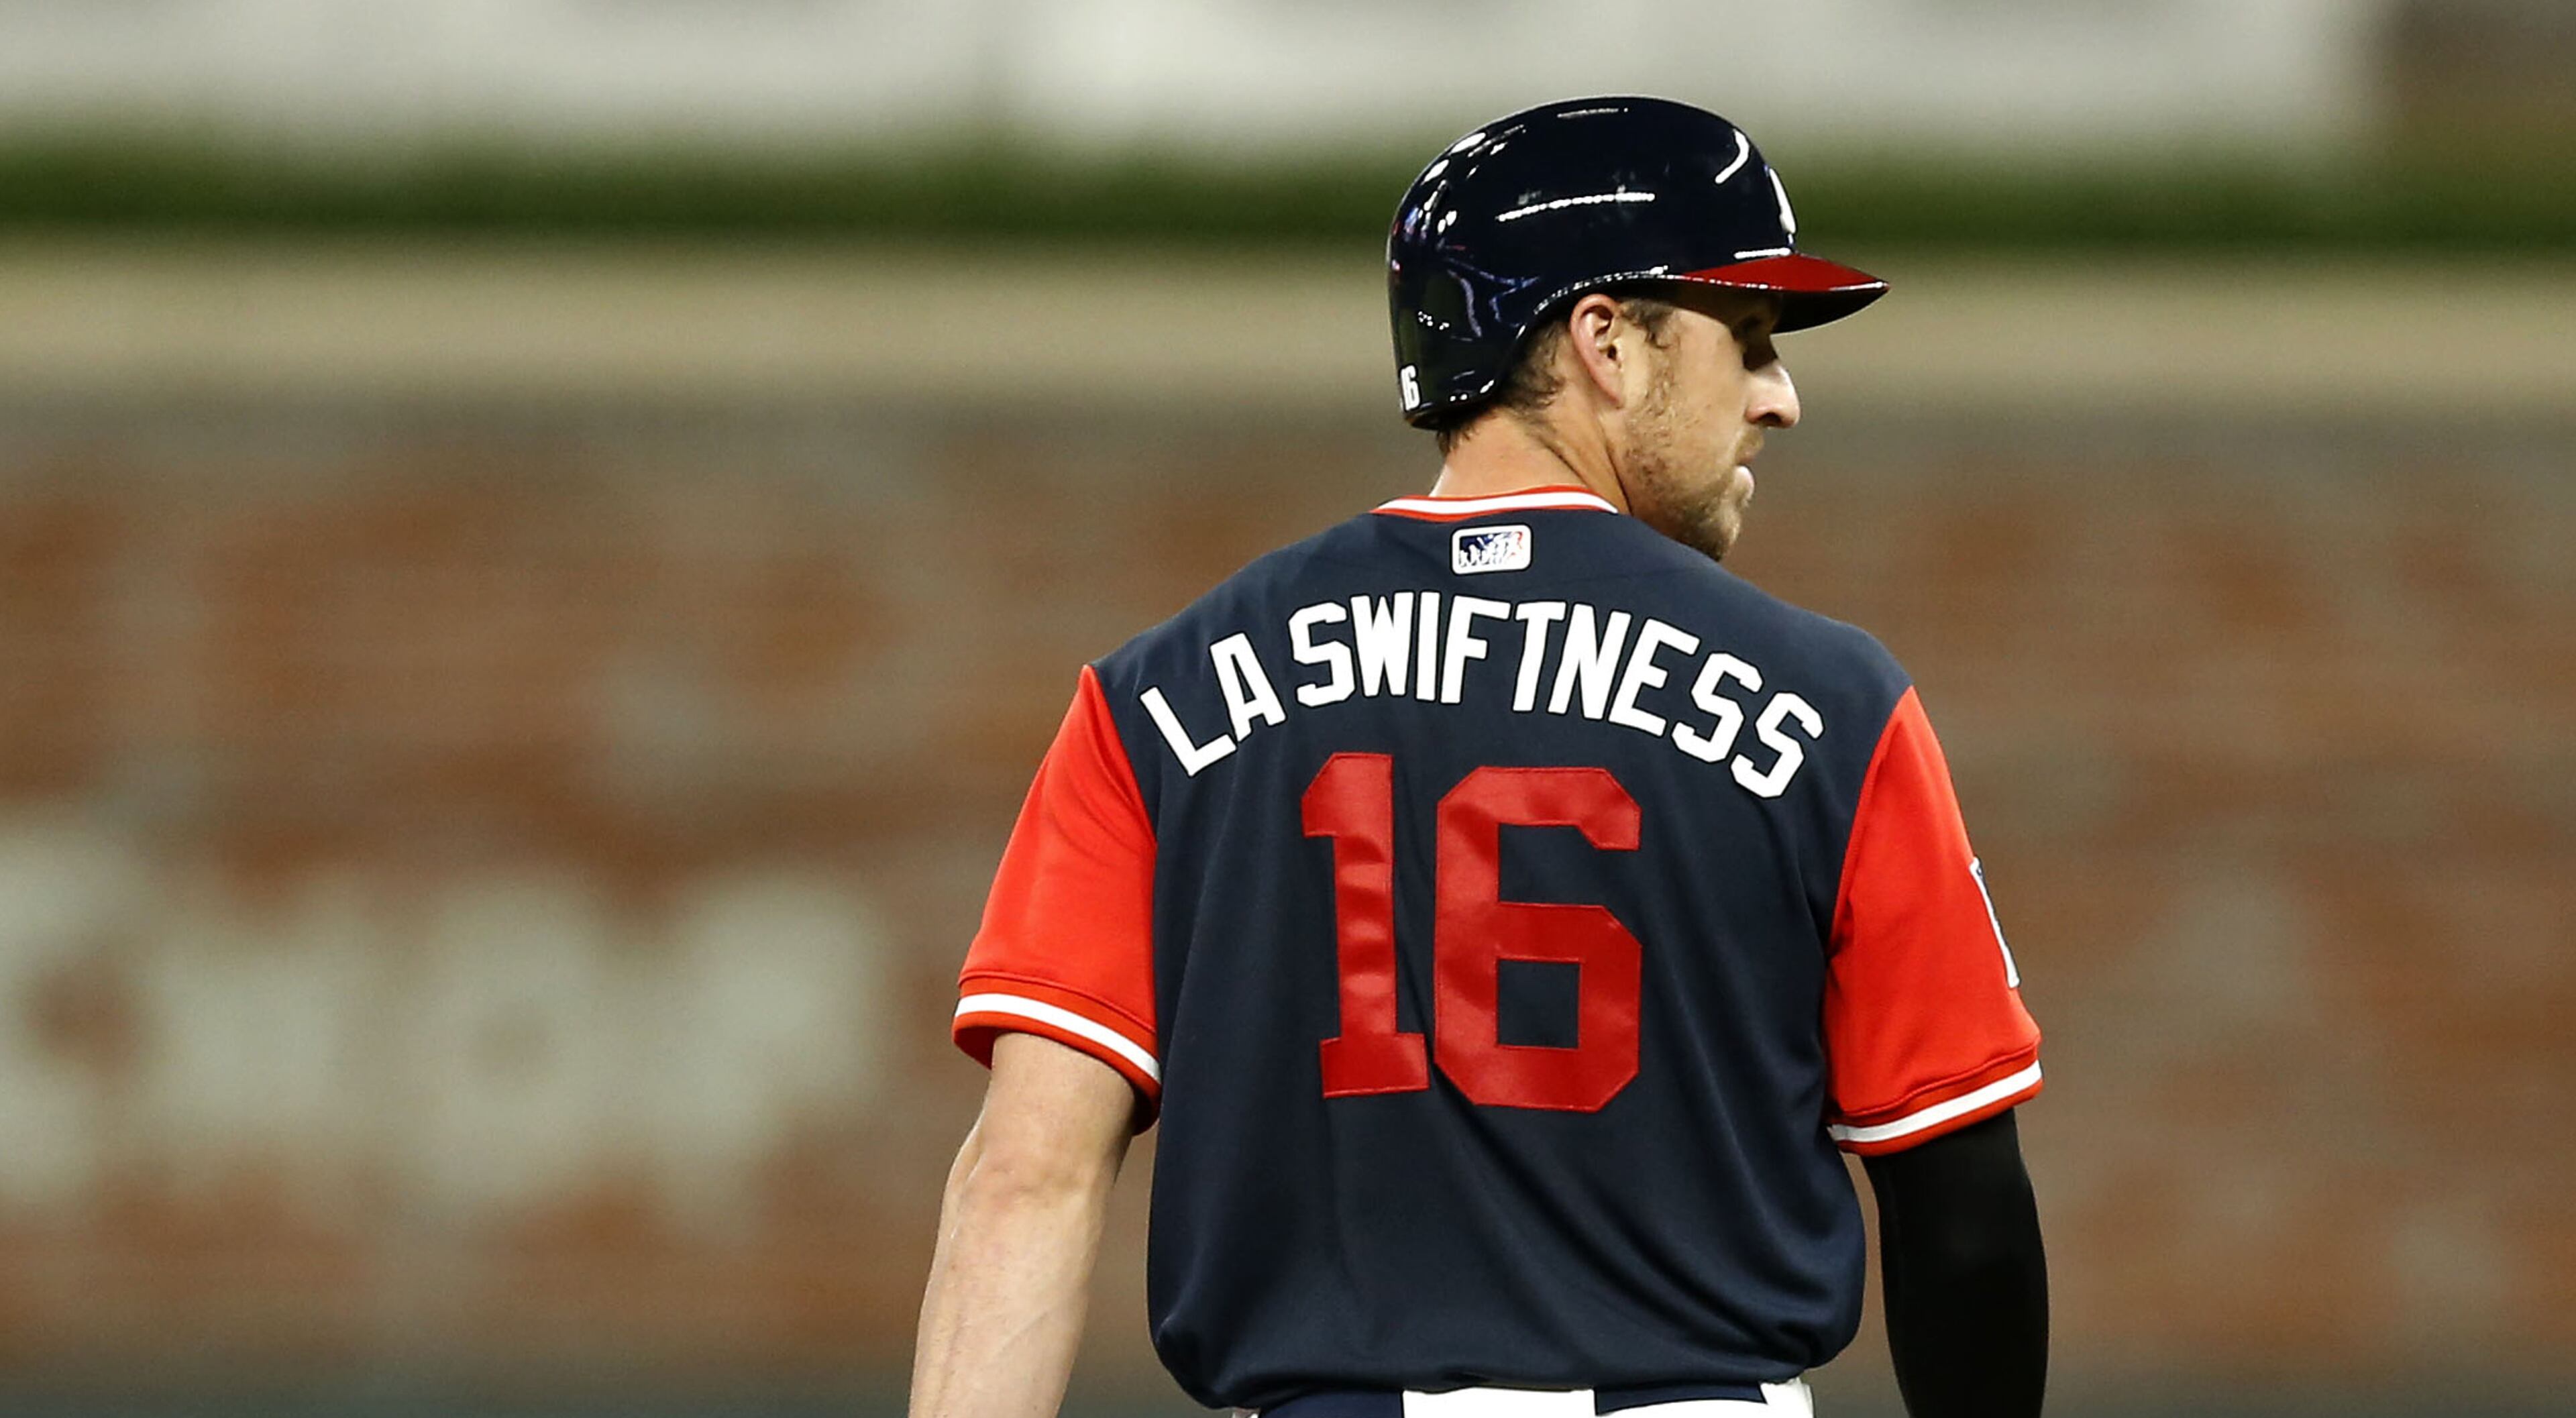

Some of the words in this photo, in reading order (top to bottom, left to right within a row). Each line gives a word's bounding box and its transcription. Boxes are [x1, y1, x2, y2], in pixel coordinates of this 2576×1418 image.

[1140, 633, 1286, 777] LA
[1288, 591, 1824, 798] SWIFTNESS
[1301, 751, 1642, 1112] 16
